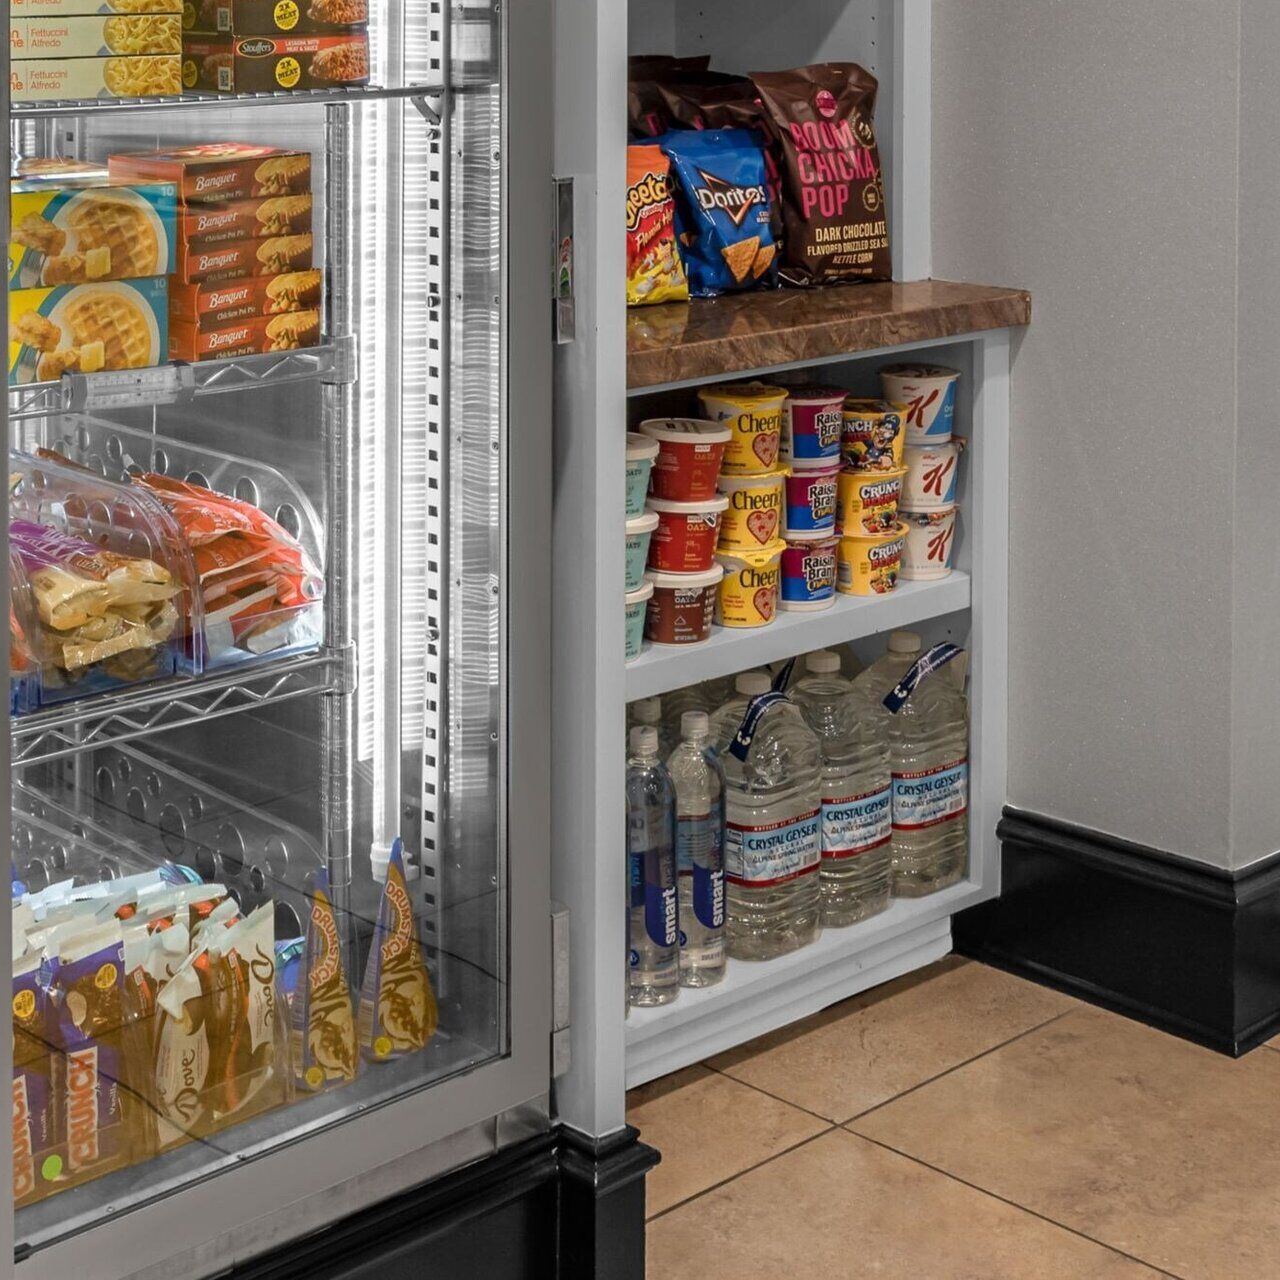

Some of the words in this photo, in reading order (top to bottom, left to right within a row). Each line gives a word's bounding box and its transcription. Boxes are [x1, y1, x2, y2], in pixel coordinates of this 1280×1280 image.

[791, 120, 856, 151] BOOM
[797, 147, 876, 184] CHICKA
[196, 173, 237, 191] Banquet
[700, 185, 766, 211] Doritos
[801, 184, 850, 219] POP
[816, 227, 841, 242] DARK
[843, 221, 886, 239] CHOCOLATE
[832, 254, 856, 264] KETTLE
[858, 253, 873, 263] CORN
[210, 289, 247, 308] Banquet
[209, 328, 248, 348] Banquet
[804, 556, 835, 569] Raisin
[808, 569, 833, 581] Bran
[827, 807, 862, 822] CRYSTAL
[865, 797, 890, 815] GEYSER
[748, 832, 785, 851] CRYSTAL
[786, 823, 817, 843] GEYSER
[712, 870, 723, 927] smart
[381, 882, 415, 960] DRUMSTICK
[666, 887, 676, 946] smart
[311, 906, 340, 987] DRUMSTICK
[251, 943, 275, 1028] Dove
[68, 1051, 97, 1167] CRUNCH
